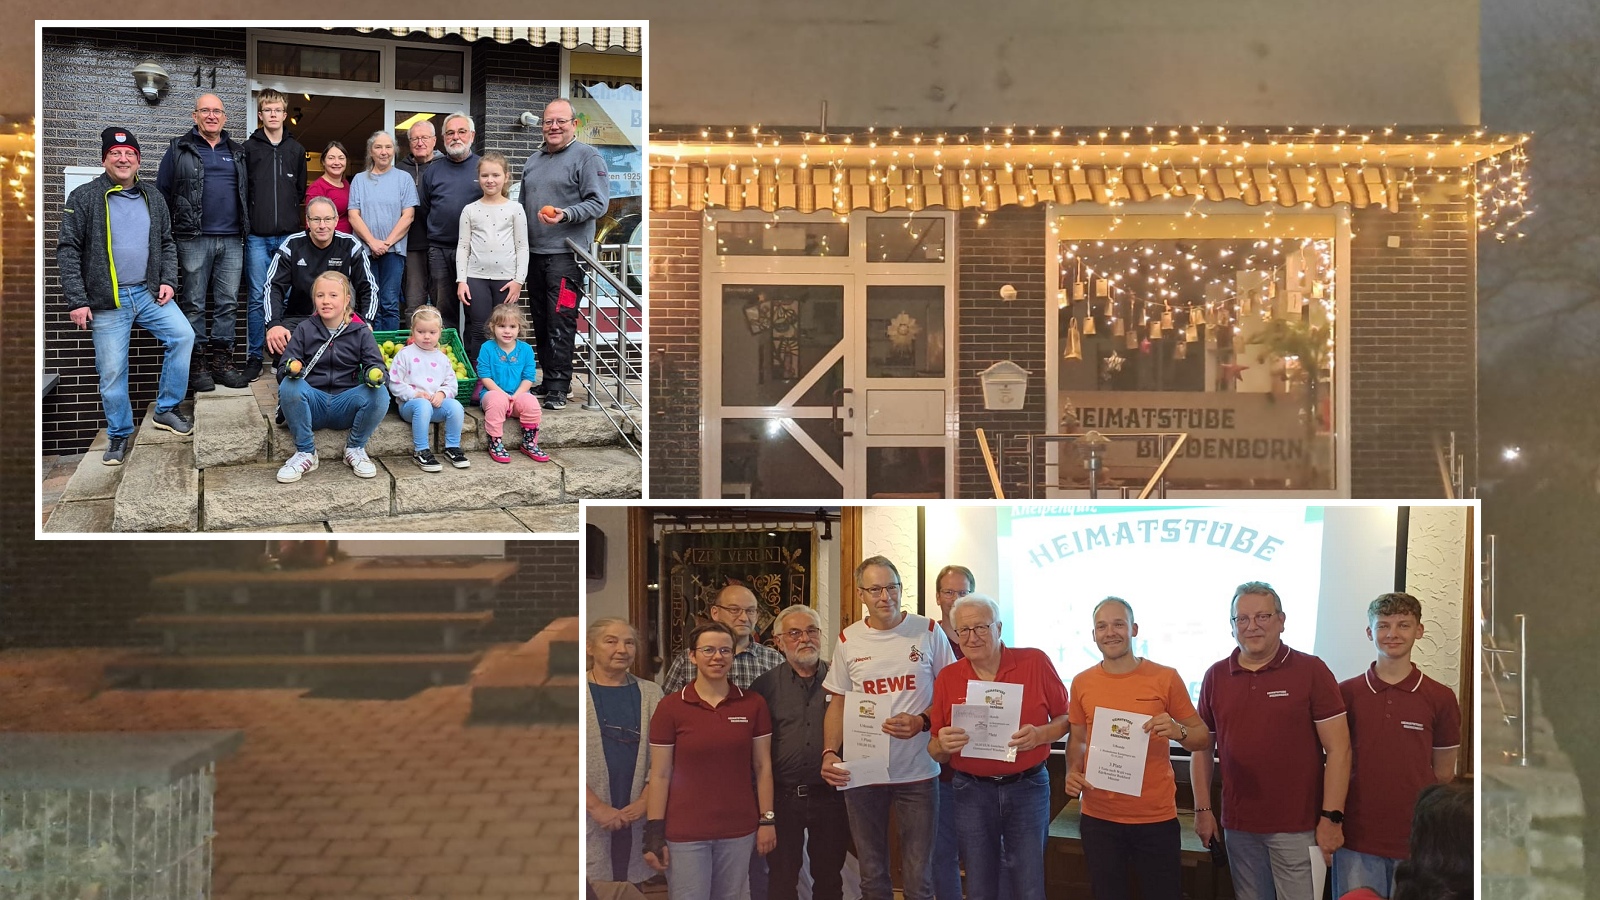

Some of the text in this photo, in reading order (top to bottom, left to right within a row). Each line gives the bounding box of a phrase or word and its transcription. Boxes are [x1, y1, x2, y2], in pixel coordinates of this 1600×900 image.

[193, 66, 216, 89] 11
[623, 172, 641, 180] 1925
[863, 675, 917, 695] REWE
